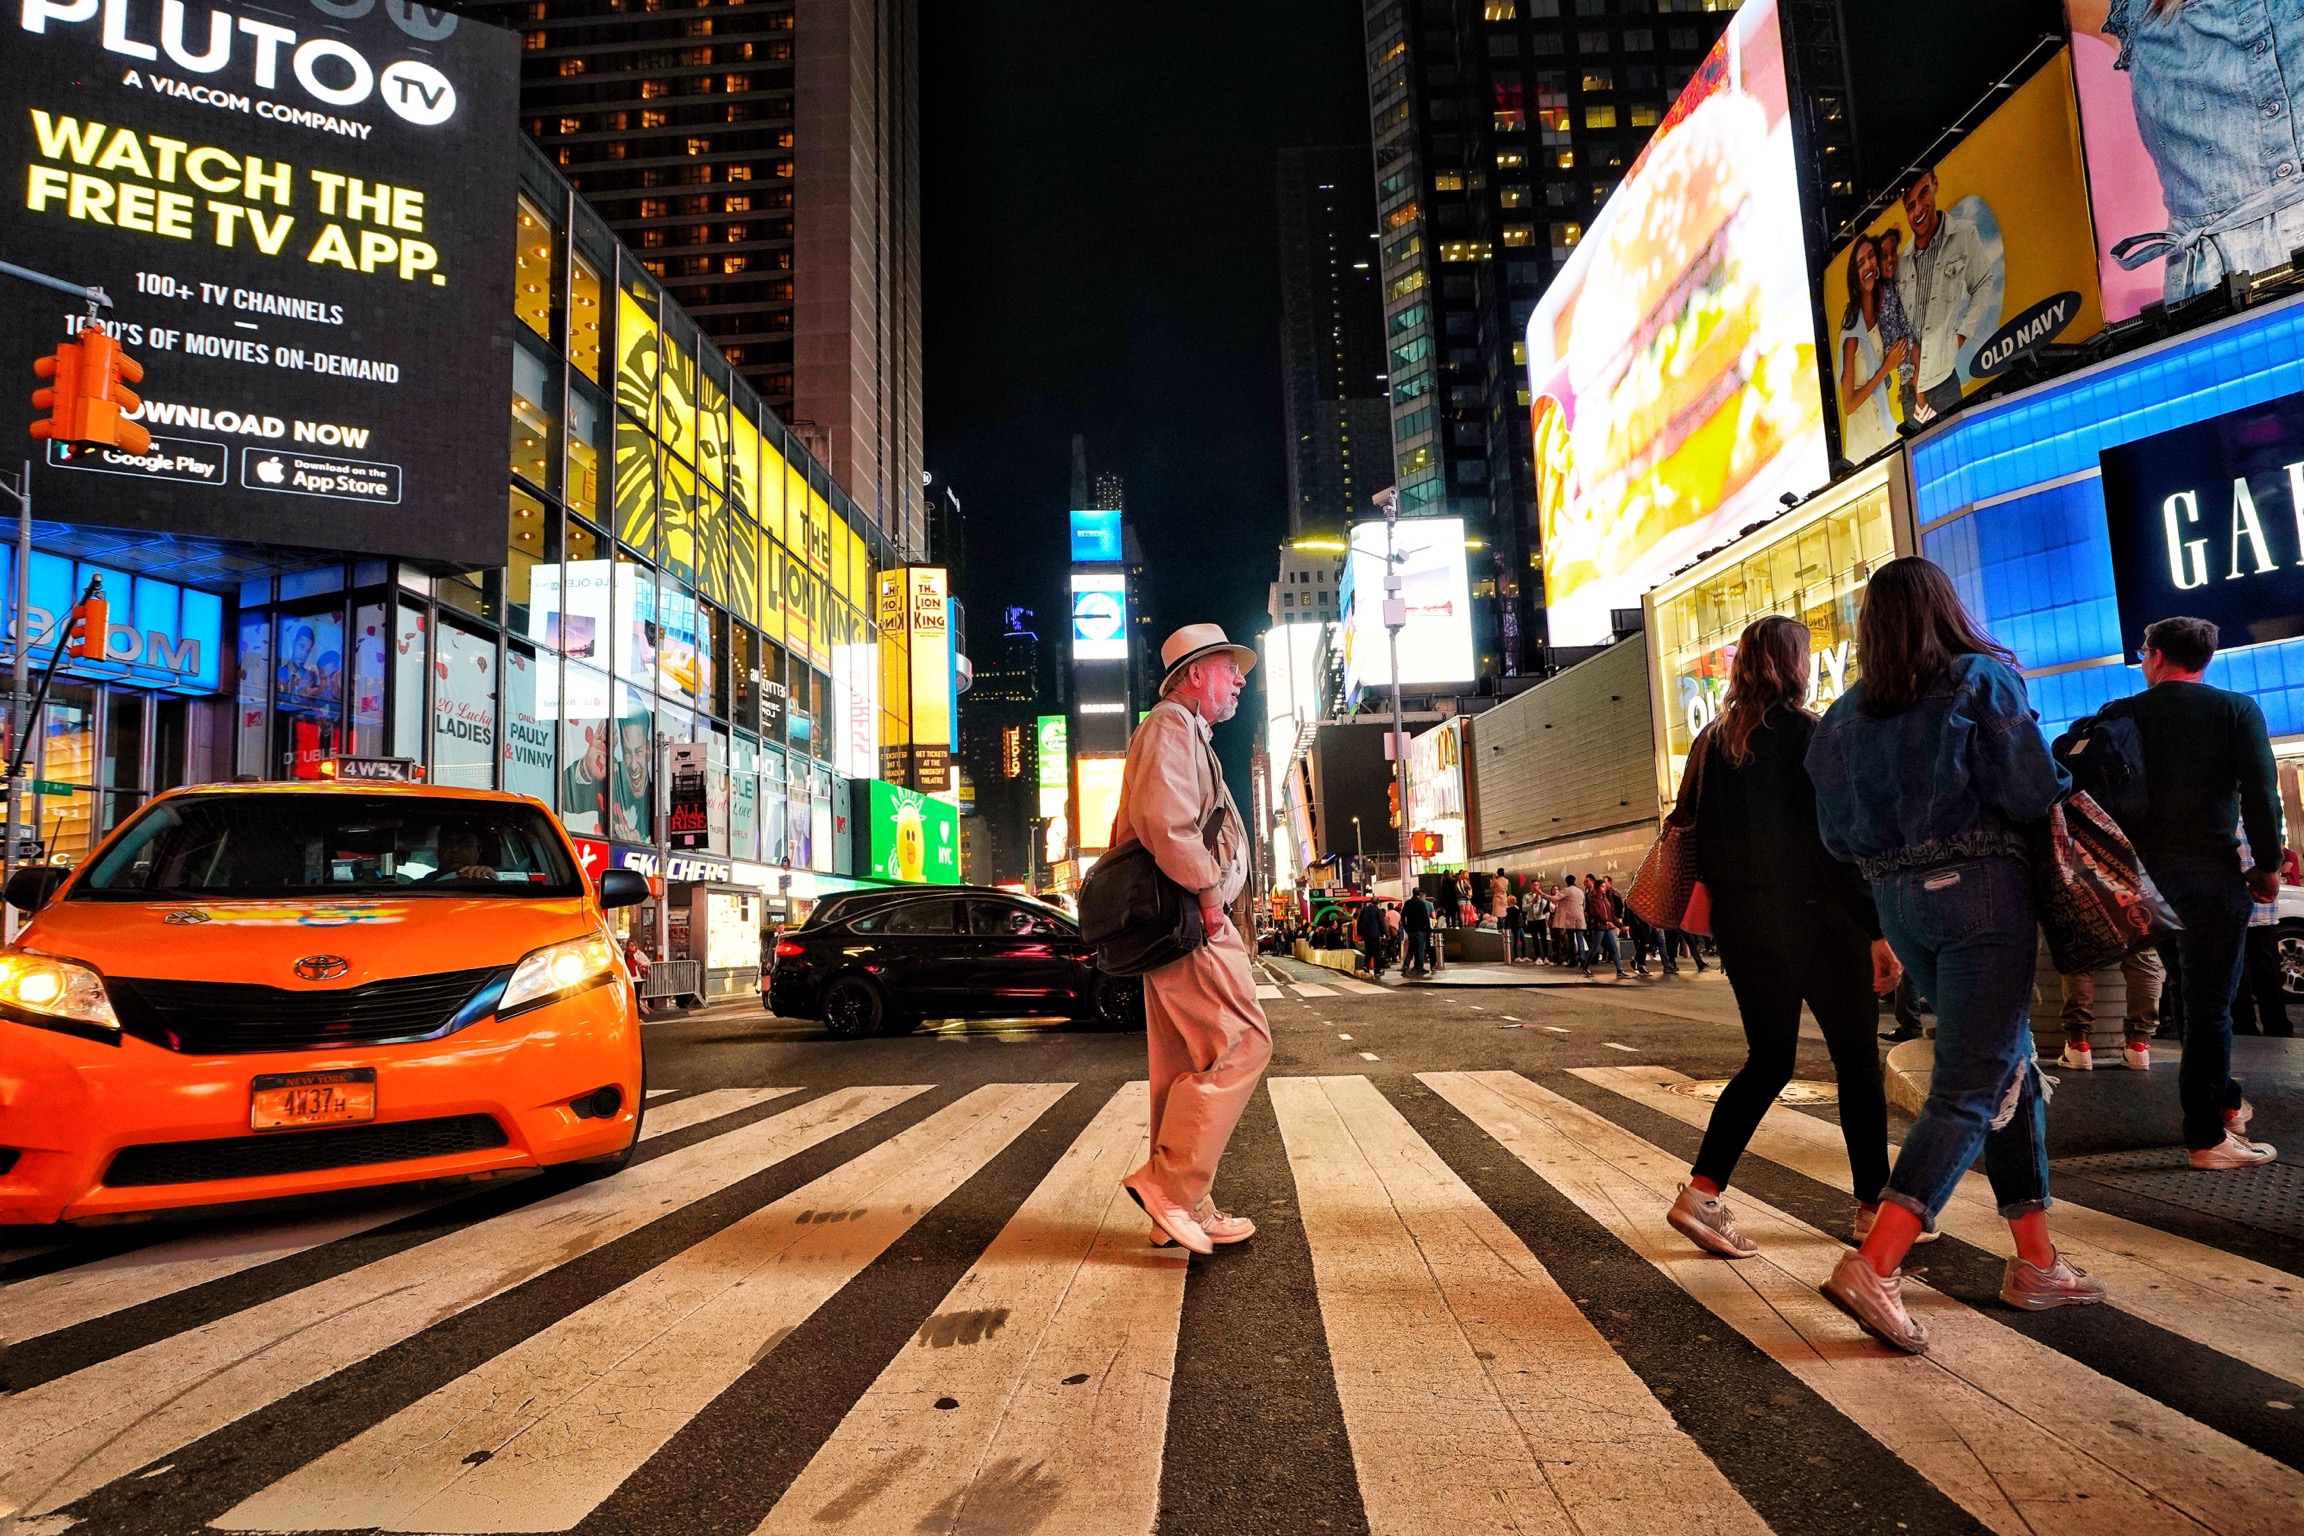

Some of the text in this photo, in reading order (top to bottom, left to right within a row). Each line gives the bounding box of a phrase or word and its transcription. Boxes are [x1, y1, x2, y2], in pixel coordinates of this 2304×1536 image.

[20, 0, 446, 110] PLUTO TV
[122, 69, 372, 140] A VIACOM COMPANY
[29, 109, 425, 233] WATCH THE
[26, 163, 447, 287] FREE TV APP.
[136, 271, 344, 326] 100+ TV CHANNELS
[1980, 299, 2067, 371] OLD NAVY
[149, 328, 179, 351] OF
[185, 335, 269, 365] MOVIES
[275, 347, 400, 384] ON-DEMAND
[120, 401, 370, 449] OWNLOAD NOW
[102, 449, 215, 478] Google Play
[294, 459, 387, 478] Download on the
[293, 470, 388, 496] App Store
[800, 509, 829, 566] THE
[2161, 460, 2304, 590] GA
[768, 525, 861, 648] LION KING
[918, 584, 936, 593] TH
[915, 595, 941, 610] LION
[914, 612, 945, 630] KING
[435, 696, 493, 729] 20 Lucky
[435, 715, 491, 746] LADIES
[510, 722, 548, 747] PAULY
[284, 747, 339, 765] DUBLE
[504, 742, 553, 769] & VINNY
[926, 750, 948, 758] TICKETS
[1009, 726, 1020, 777] NOVOTEL
[344, 761, 402, 779] 4W37
[671, 816, 708, 831] RISE
[675, 803, 706, 818] ALL
[624, 852, 730, 882] SKCHERS
[938, 845, 953, 865] NYC
[2067, 818, 2152, 899] HARDROCKREWARDS.CO
[285, 1074, 347, 1086] NEW YORK
